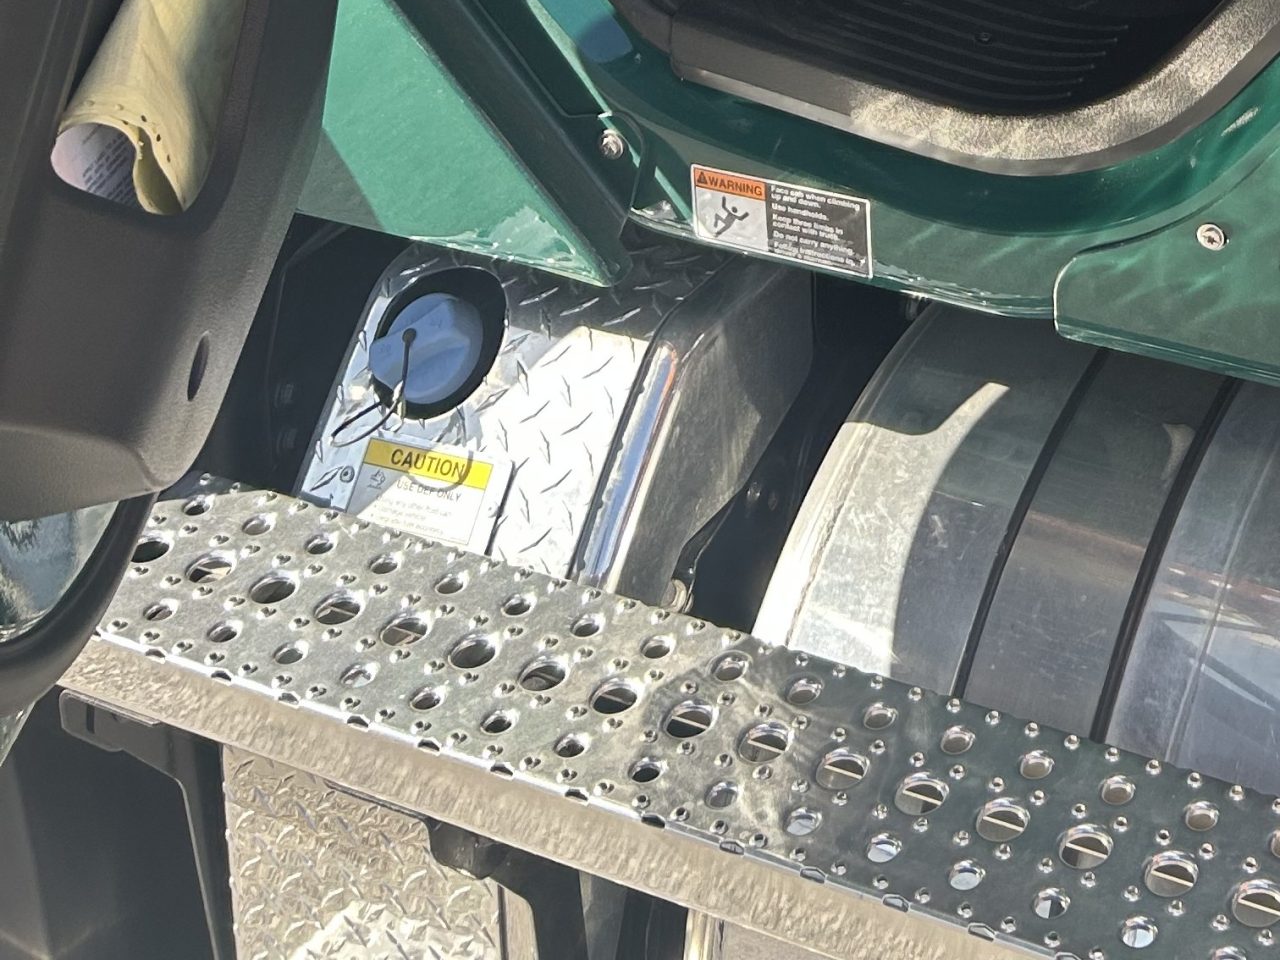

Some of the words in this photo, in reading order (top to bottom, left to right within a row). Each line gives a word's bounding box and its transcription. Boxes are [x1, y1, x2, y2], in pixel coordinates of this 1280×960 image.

[707, 178, 762, 196] WARNING
[771, 185, 788, 195] Face
[806, 193, 825, 202] when
[827, 197, 860, 211] climbing
[783, 195, 796, 203] and
[772, 203, 786, 211] Use
[773, 214, 791, 224] Keep
[793, 219, 811, 227] three
[774, 230, 784, 238] Do
[800, 237, 818, 247] carry
[802, 227, 817, 235] with
[391, 449, 465, 478] CAUTION
[396, 480, 414, 492] USE
[437, 489, 461, 502] ONLY
